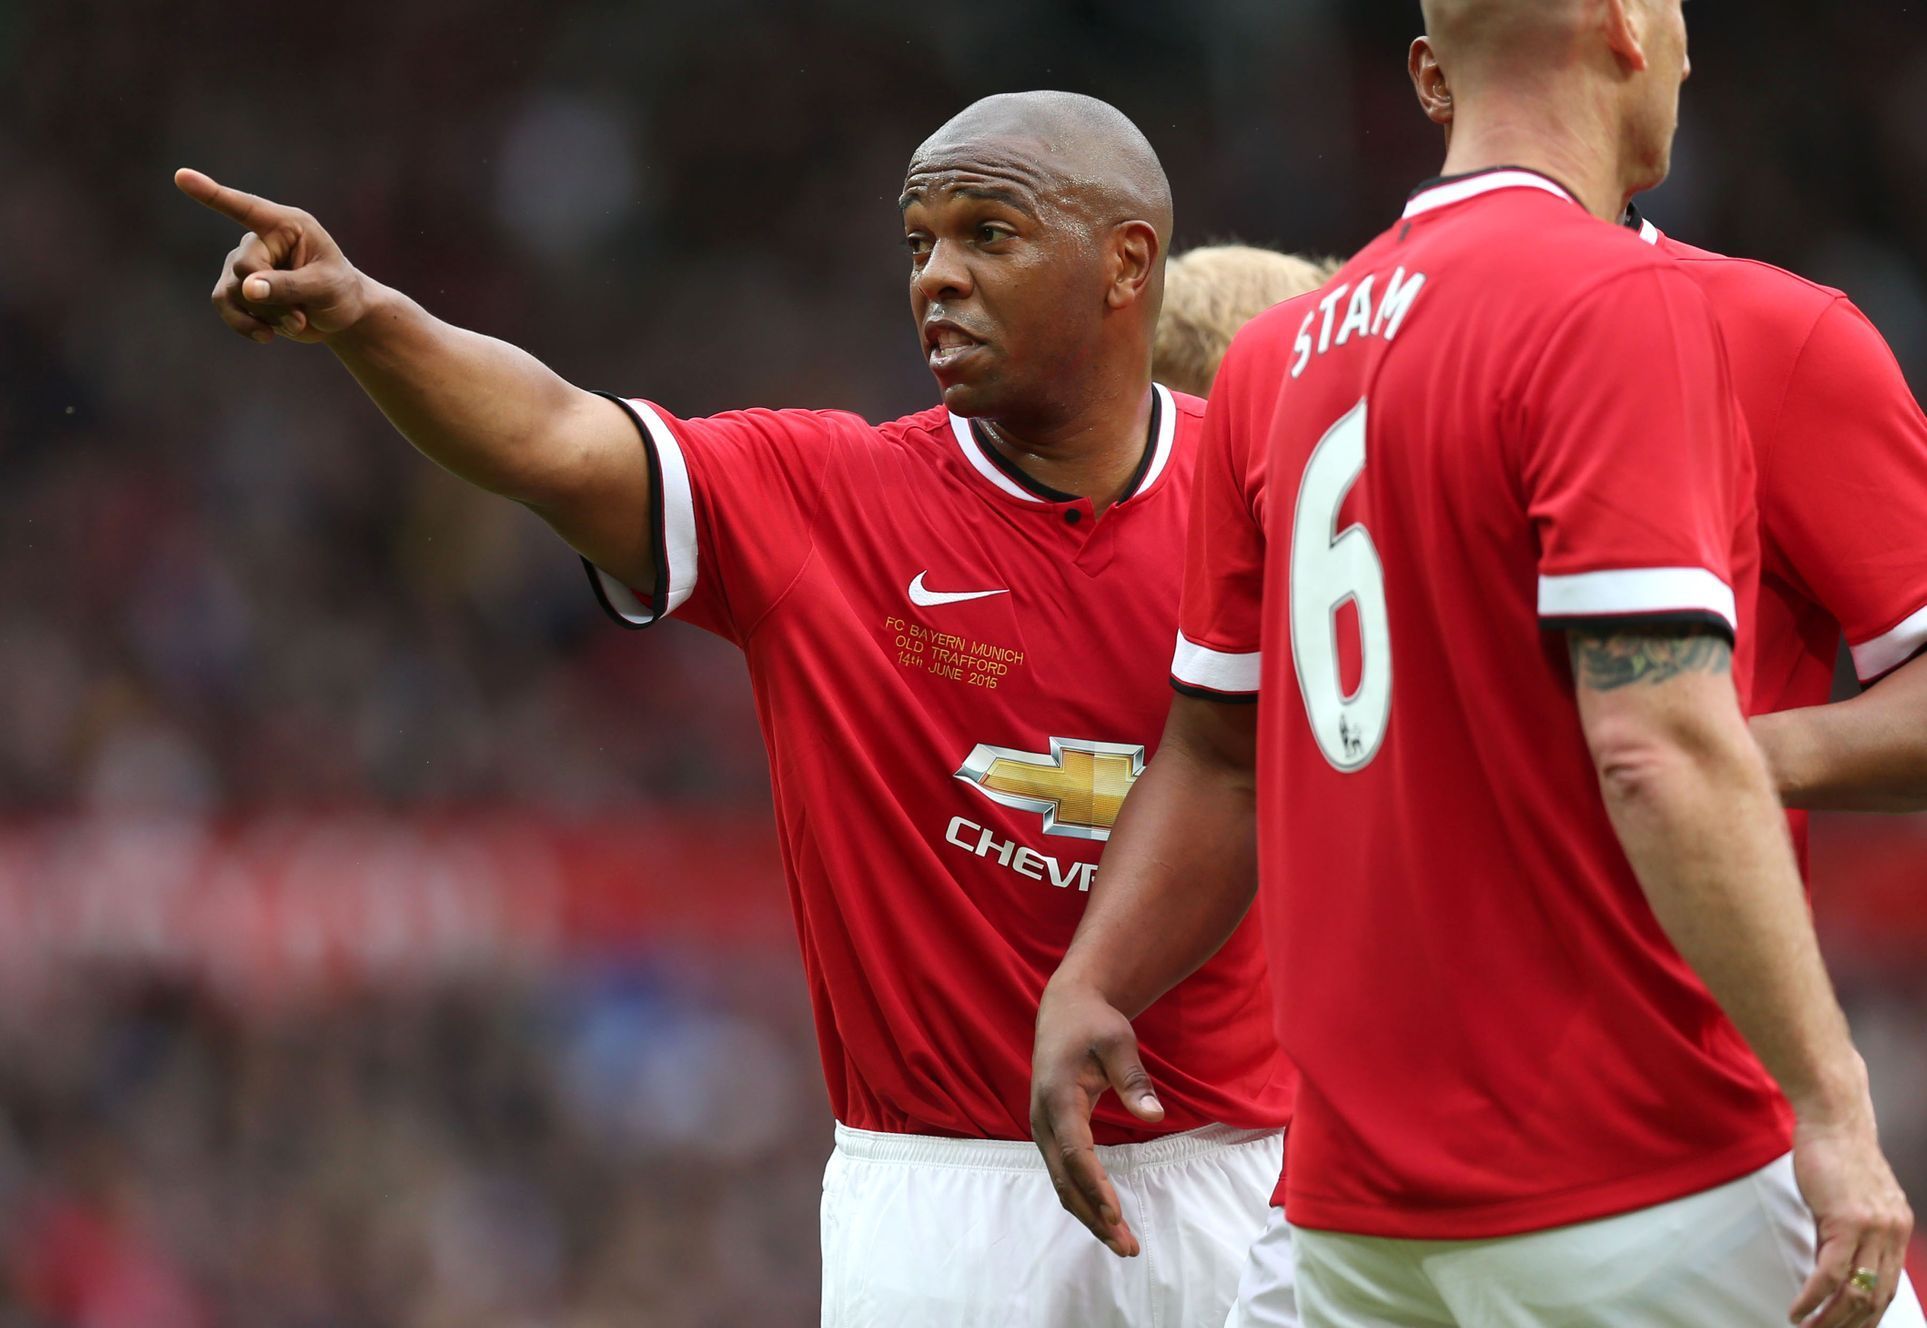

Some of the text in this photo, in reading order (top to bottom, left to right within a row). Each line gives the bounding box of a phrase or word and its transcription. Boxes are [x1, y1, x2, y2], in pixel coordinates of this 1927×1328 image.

[1291, 265, 1426, 379] STAM
[1289, 396, 1392, 772] 6
[885, 616, 1024, 665] FC BAYERN MUNICH
[895, 635, 1008, 676] OLD TRAFFORD
[898, 651, 998, 689] 14th JUNE 2015
